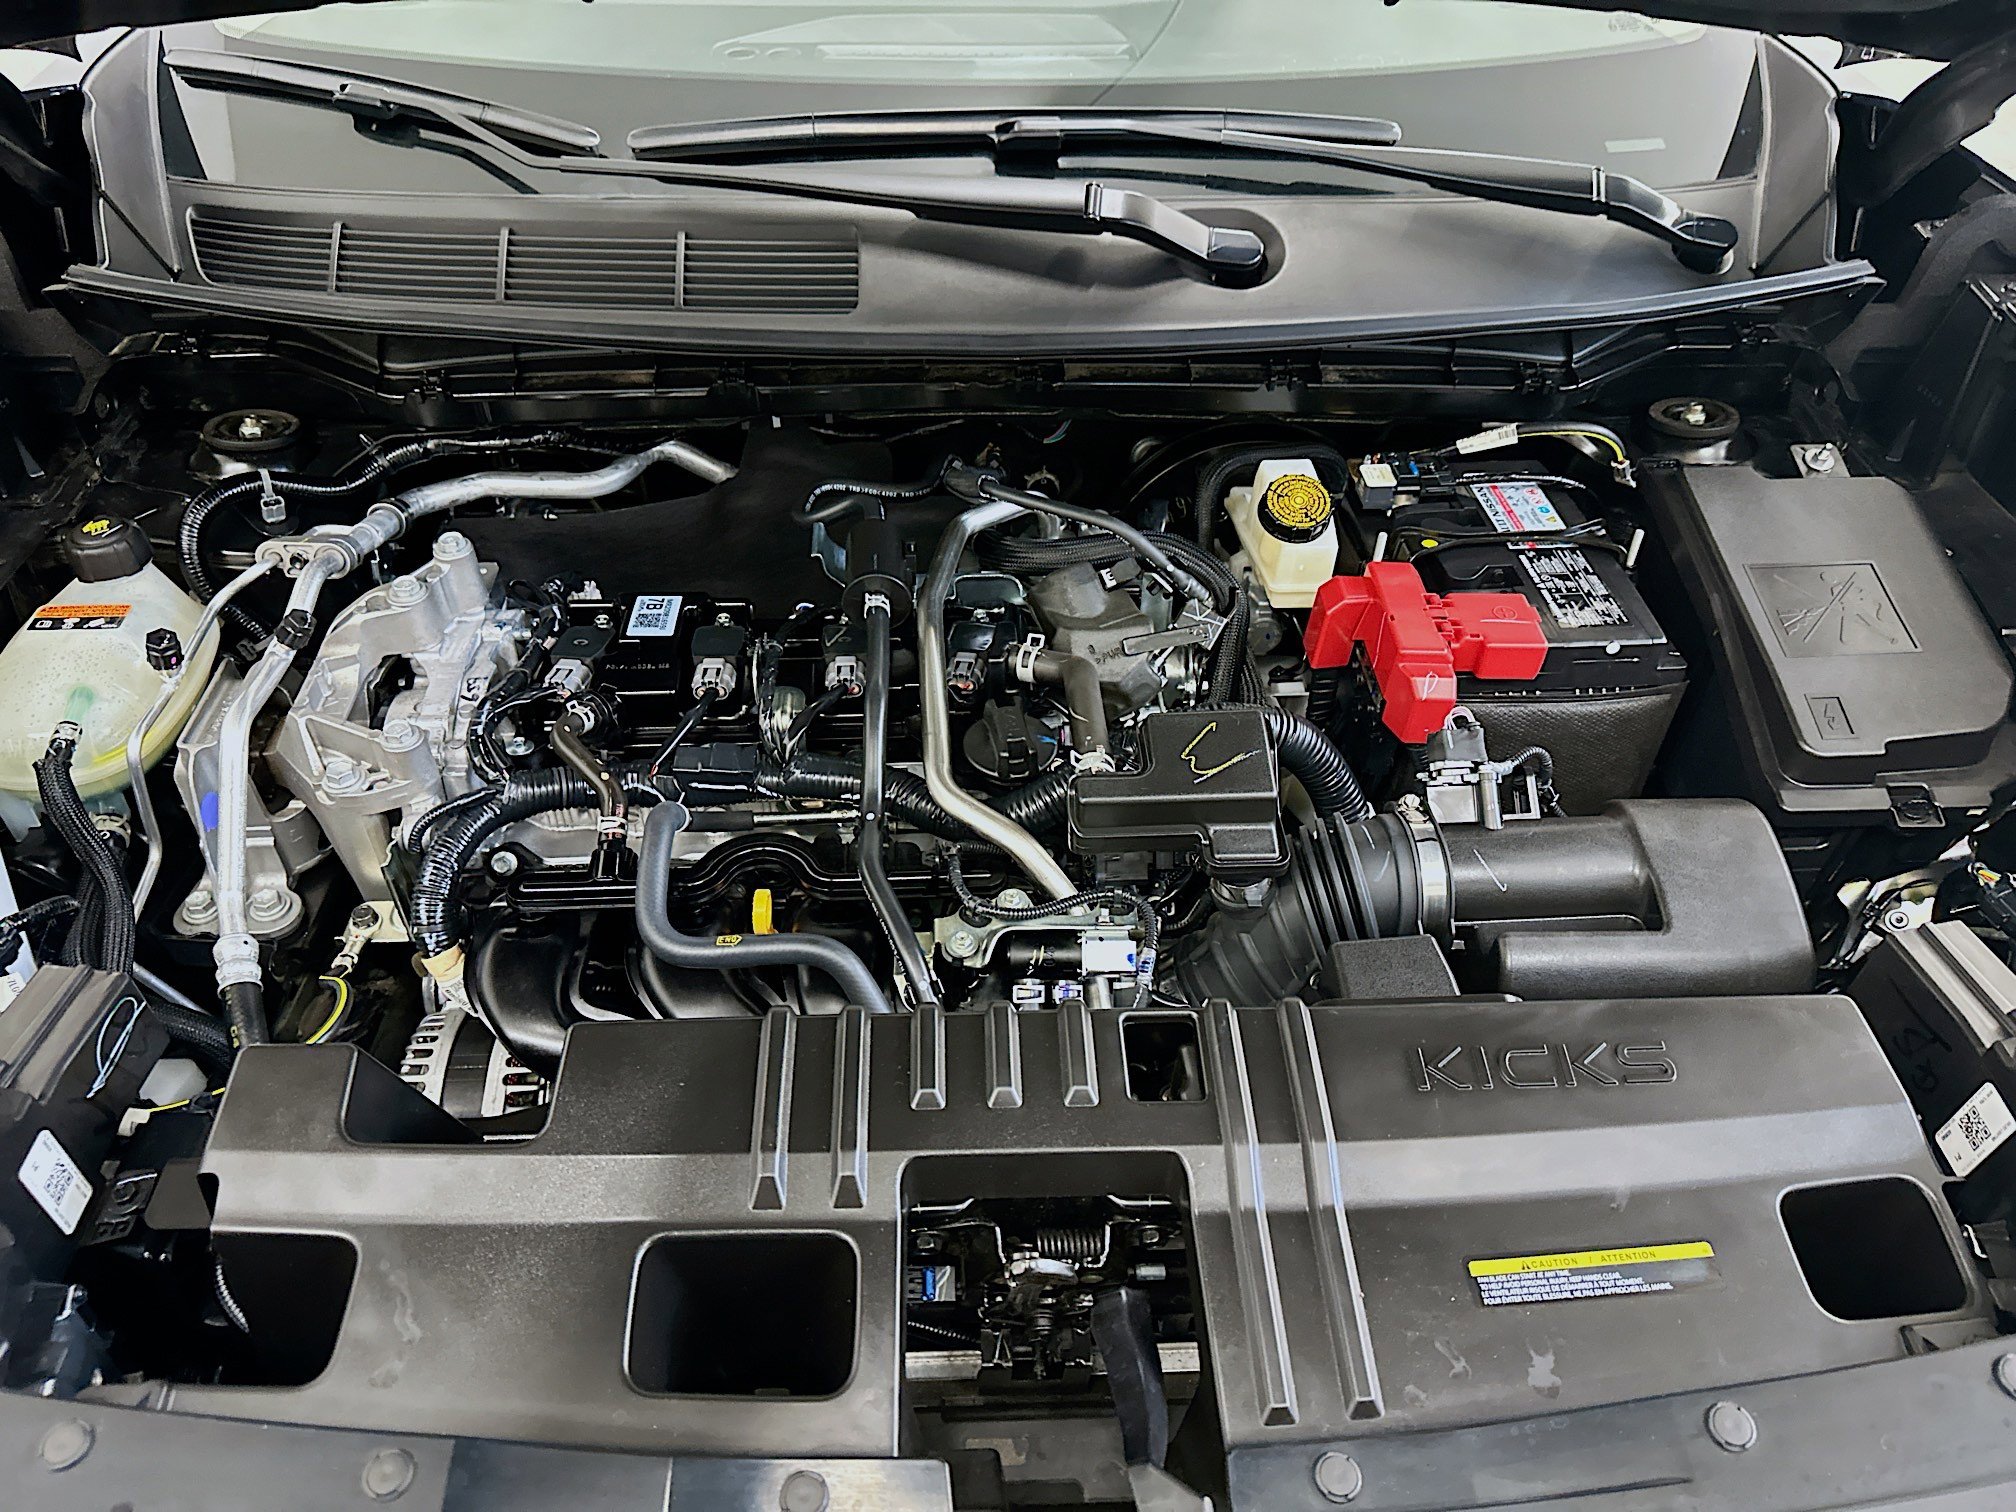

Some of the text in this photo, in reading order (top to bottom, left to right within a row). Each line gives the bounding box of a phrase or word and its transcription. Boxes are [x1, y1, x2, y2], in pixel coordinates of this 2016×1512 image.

[1475, 486, 1502, 517] NISSAN
[646, 597, 665, 610] 7B
[1413, 1040, 1679, 1091] KICKS
[1531, 1258, 1578, 1269] CAUTION
[1600, 1251, 1657, 1263] ATTENTION
